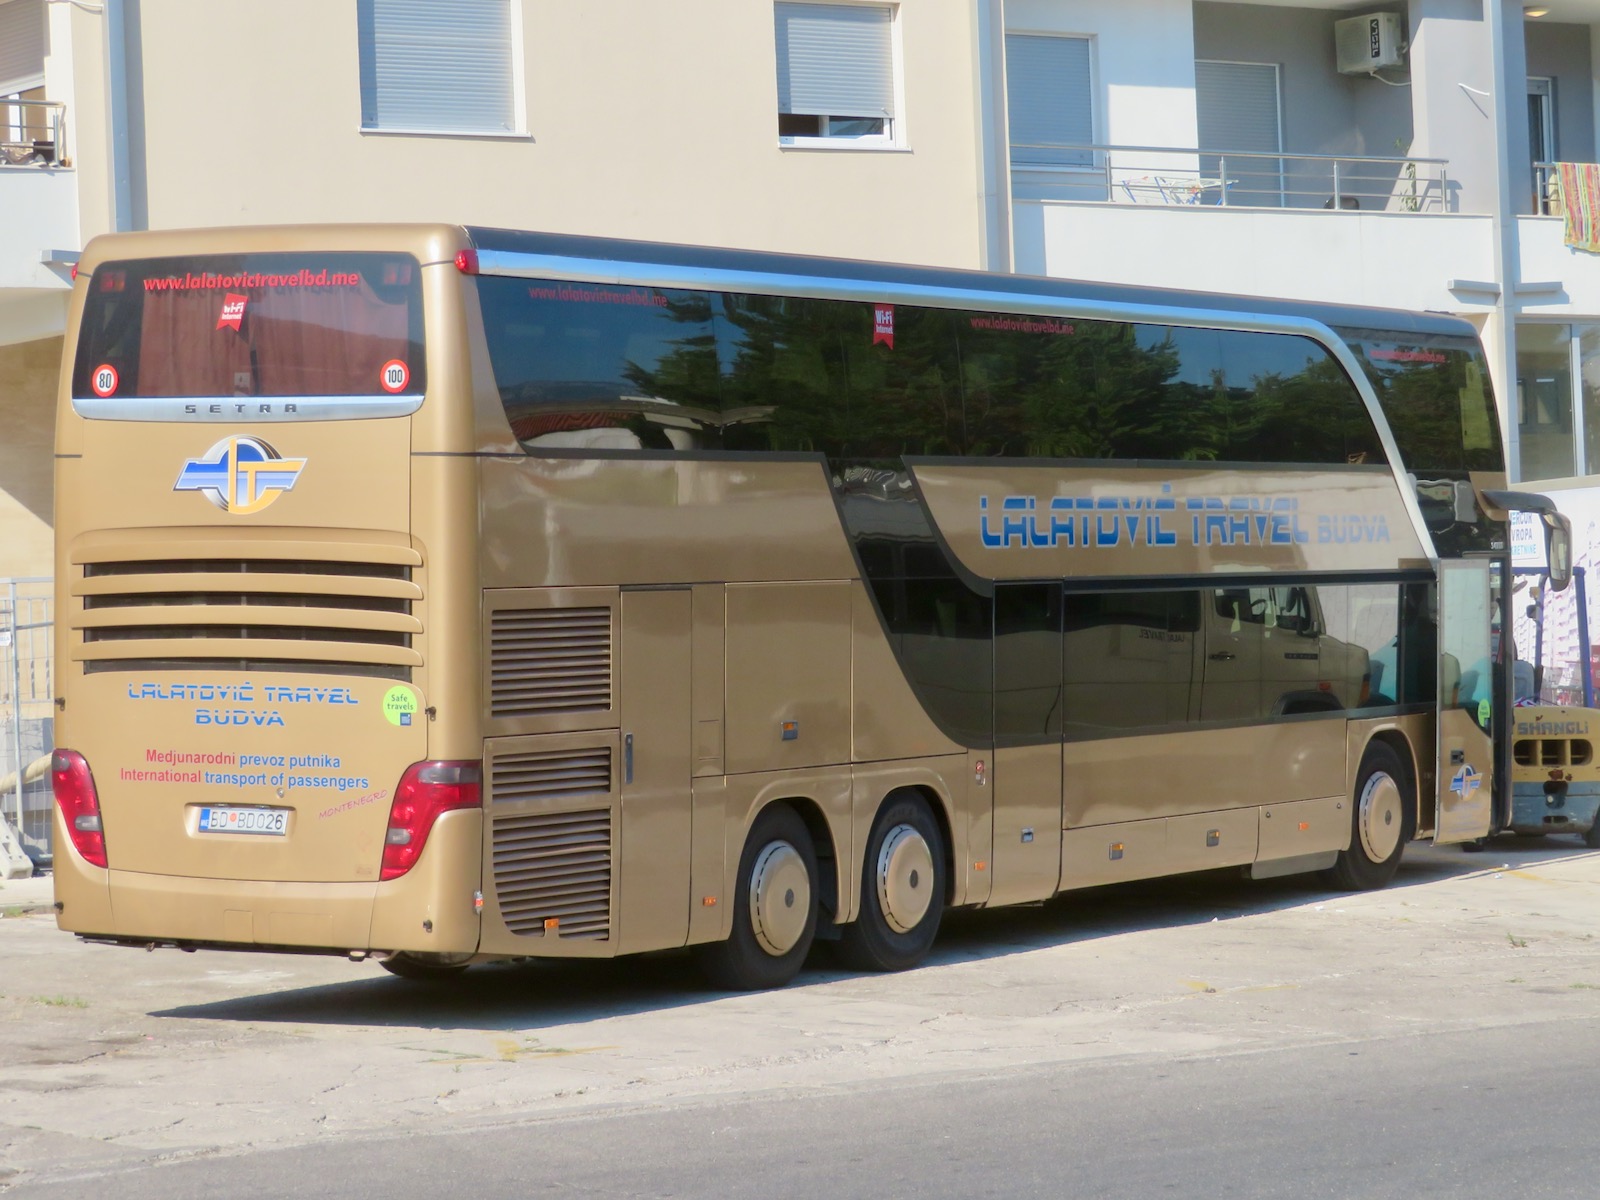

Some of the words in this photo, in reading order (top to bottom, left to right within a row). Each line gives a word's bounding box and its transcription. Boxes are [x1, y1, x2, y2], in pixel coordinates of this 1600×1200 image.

[143, 269, 359, 291] www.lalatovictravelbd.me
[98, 372, 113, 390] 80
[386, 369, 404, 385] 100
[184, 403, 298, 414] SETRA
[1185, 495, 1309, 548] TRAVEL
[1317, 514, 1391, 546] BUDVA
[264, 686, 359, 705] TRAVEL
[391, 694, 408, 702] Safe
[387, 702, 414, 711] travels
[195, 709, 285, 727] BUDVA
[146, 748, 236, 766] Medjunarodni
[239, 753, 286, 769] prevoz
[289, 753, 341, 770] putnika
[120, 768, 201, 783] International
[205, 771, 267, 788] transport
[270, 773, 284, 787] of
[288, 776, 369, 792] passengers
[318, 789, 388, 820] MONTENEGRO
